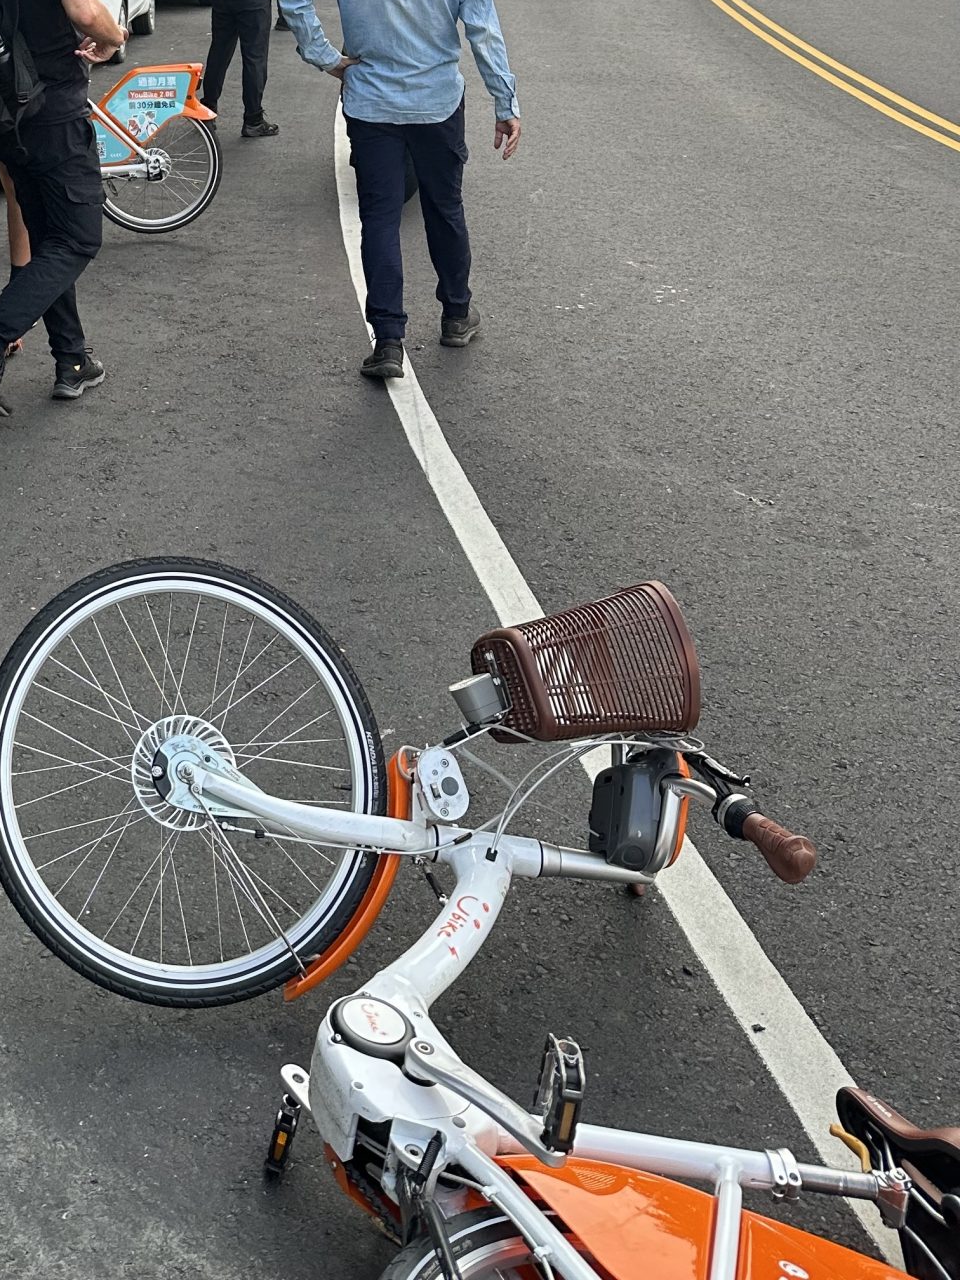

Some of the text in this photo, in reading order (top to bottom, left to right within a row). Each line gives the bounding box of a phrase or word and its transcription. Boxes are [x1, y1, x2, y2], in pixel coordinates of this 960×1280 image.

[138, 76, 177, 87] 通勤月票
[129, 90, 175, 99] YouBike 2.0E
[365, 731, 377, 764] KENDA
